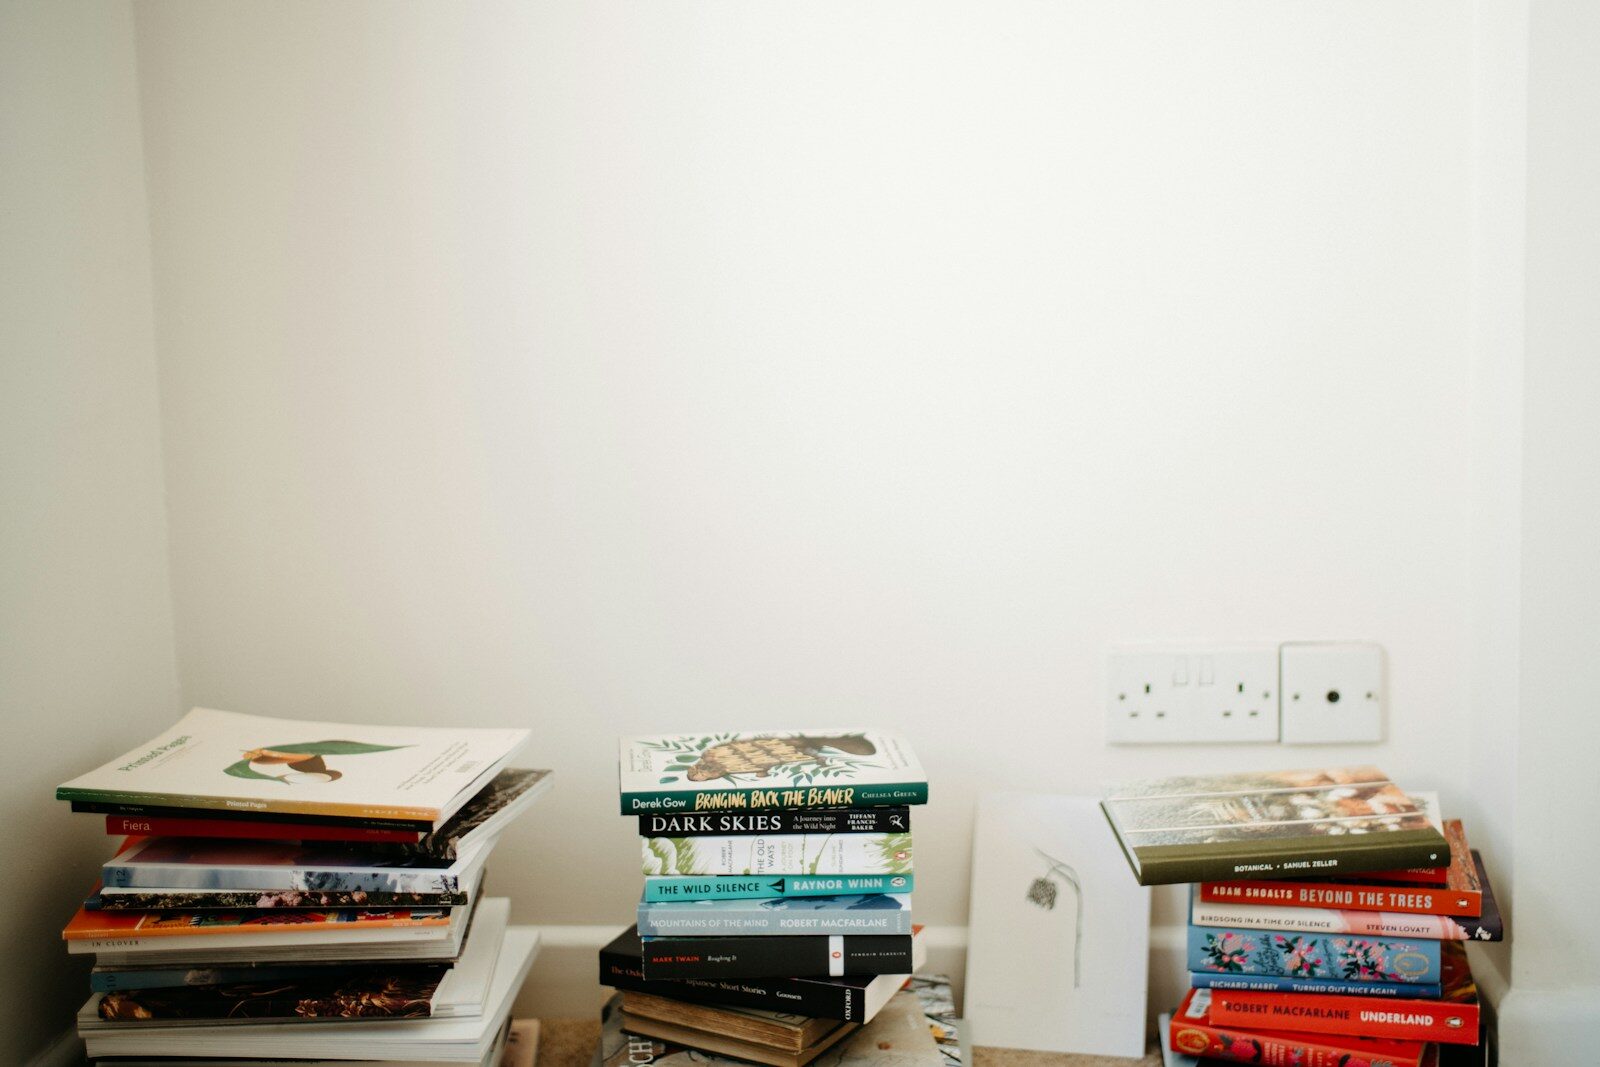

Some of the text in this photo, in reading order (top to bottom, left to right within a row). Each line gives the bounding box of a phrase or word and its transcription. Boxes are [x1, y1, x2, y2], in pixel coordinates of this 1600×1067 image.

[226, 800, 267, 810] Printed Pages
[632, 797, 686, 809] Derek Gow
[695, 787, 854, 811] BRINGING BACK THE BEAVER
[652, 815, 782, 832] DARK SKIES
[800, 816, 822, 824] Journey
[1234, 860, 1338, 872] BOTANICAL SAMUEL ZELLER
[658, 882, 760, 894] THE WILD SILENCE
[793, 878, 882, 890] RAYNOR WINN
[1212, 886, 1432, 909] ADAM SHOALTS BEYOND THE TREES
[650, 920, 706, 928] MOUNTAINS
[780, 919, 818, 928] ROBERT
[821, 918, 888, 927] MACFARLANE
[1200, 915, 1242, 923] BIRDSONG
[1298, 920, 1331, 928] SILENCE
[1366, 924, 1396, 932] STEVEN
[612, 966, 623, 975] The
[720, 982, 740, 992] Short
[742, 984, 767, 996] Stories
[1210, 980, 1278, 990] RICHARD MABEY
[1292, 984, 1326, 992] TURNED
[1348, 986, 1368, 994] NICE
[1370, 987, 1397, 995] AGAIN
[1226, 1002, 1350, 1020] ROBERT MACFARLANE
[1360, 1010, 1434, 1026] UNDERLAND
